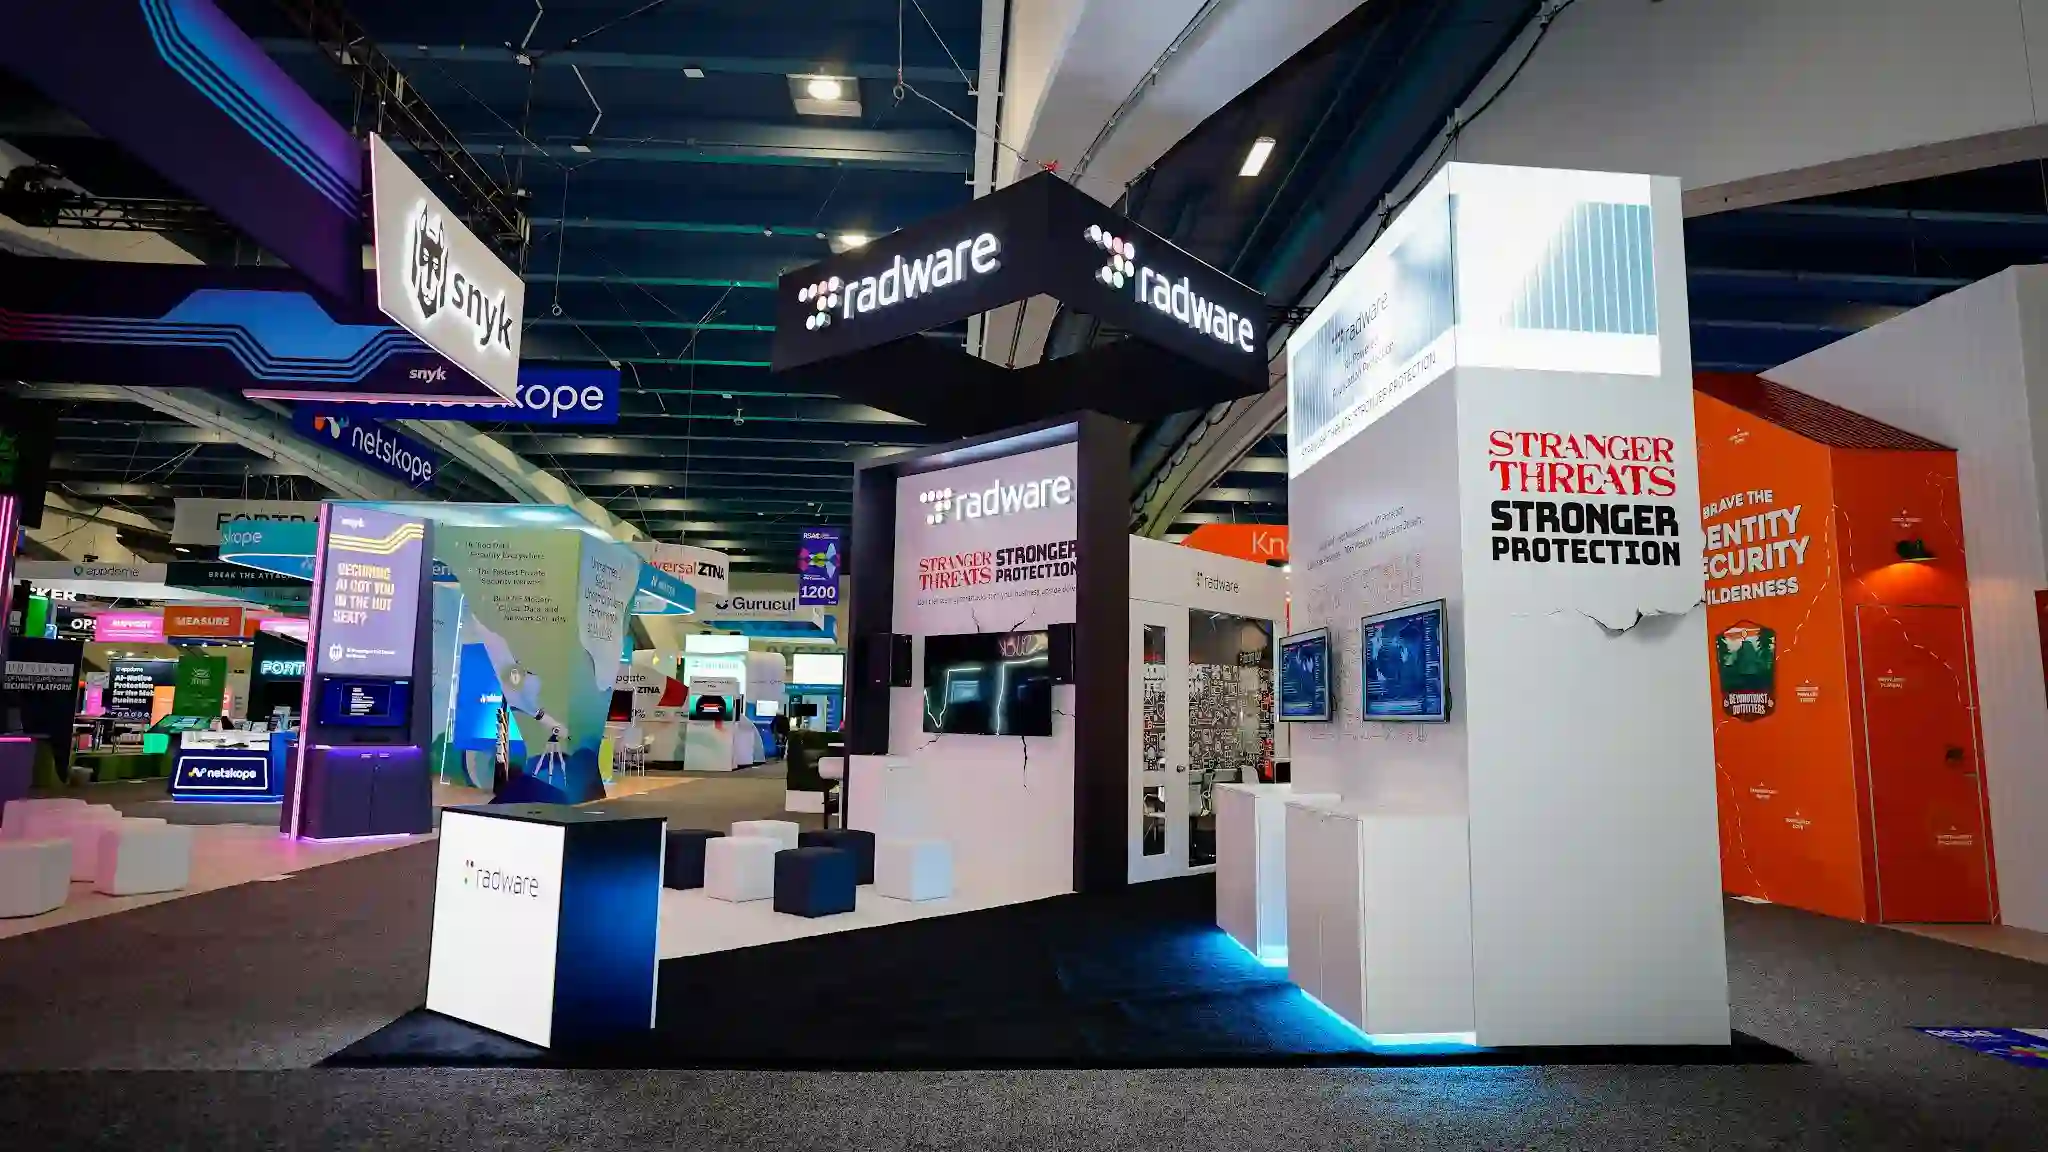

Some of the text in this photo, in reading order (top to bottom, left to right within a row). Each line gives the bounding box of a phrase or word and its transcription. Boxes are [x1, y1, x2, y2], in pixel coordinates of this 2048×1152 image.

[843, 232, 1001, 320] radware
[451, 271, 513, 352] snyk
[1140, 265, 1255, 353] radware
[409, 366, 447, 383] snyk
[352, 425, 432, 481] netskope
[1488, 430, 1675, 463] STRANGER
[1488, 460, 1677, 497] THREATS
[956, 475, 1072, 521] radware
[1703, 489, 1773, 520] BRAVE THE
[1491, 500, 1679, 537] STRONGER
[1702, 504, 1802, 551] ENTITY
[1492, 536, 1681, 567] PROTECTION
[698, 562, 725, 580] ZTNA
[919, 551, 992, 573] STRANGER
[86, 565, 140, 578] appdome
[208, 571, 236, 579] BREAK
[492, 568, 519, 577] Fastest
[919, 566, 992, 592] THREATS
[335, 578, 349, 592] AI
[374, 581, 395, 595] YOU
[801, 585, 837, 599] 1200
[1204, 575, 1240, 594] radware
[334, 593, 348, 608] IN
[350, 595, 370, 609] THE
[732, 596, 796, 612] Gurucul
[175, 616, 231, 627] MEASURE
[332, 609, 369, 627] SEAT?
[36, 683, 73, 692] PLATFORM
[113, 681, 154, 690] Protection
[637, 686, 660, 694] ZTNA
[207, 767, 257, 780] netskope
[476, 867, 540, 899] radware
